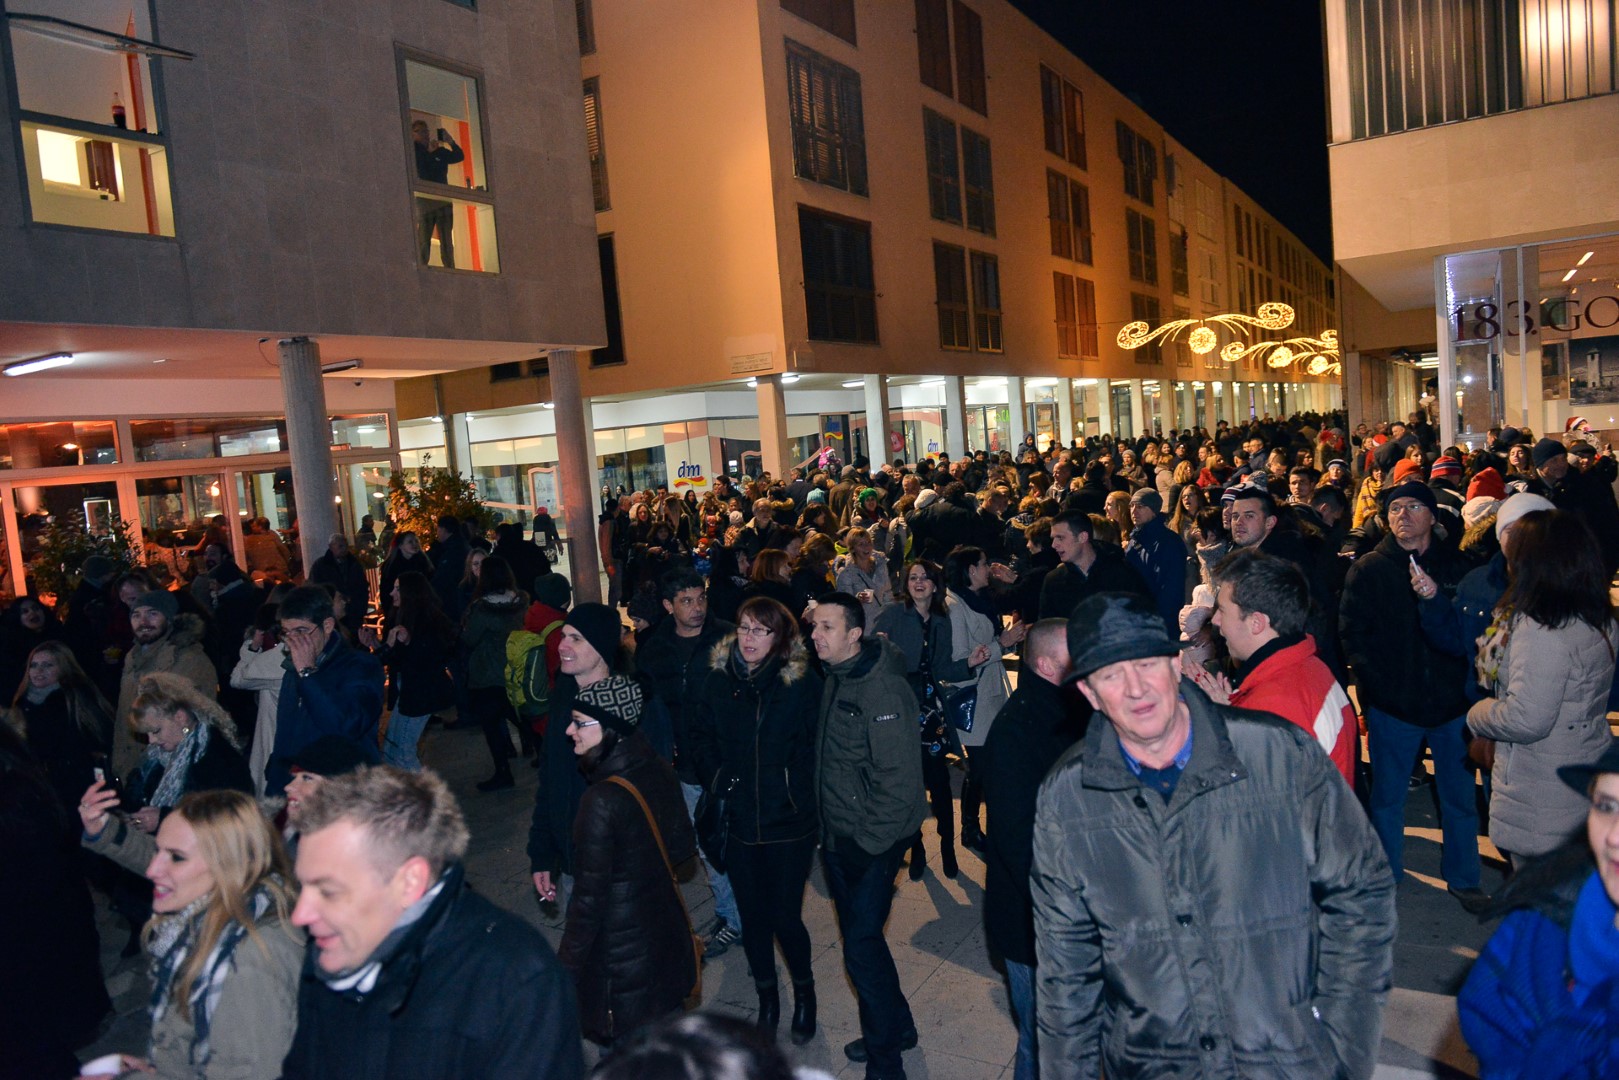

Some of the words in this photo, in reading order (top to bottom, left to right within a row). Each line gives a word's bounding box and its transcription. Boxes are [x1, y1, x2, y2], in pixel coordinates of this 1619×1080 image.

[1451, 300, 1538, 342] 183.
[1548, 295, 1619, 332] GO
[927, 438, 939, 453] dm
[677, 460, 701, 478] dm
